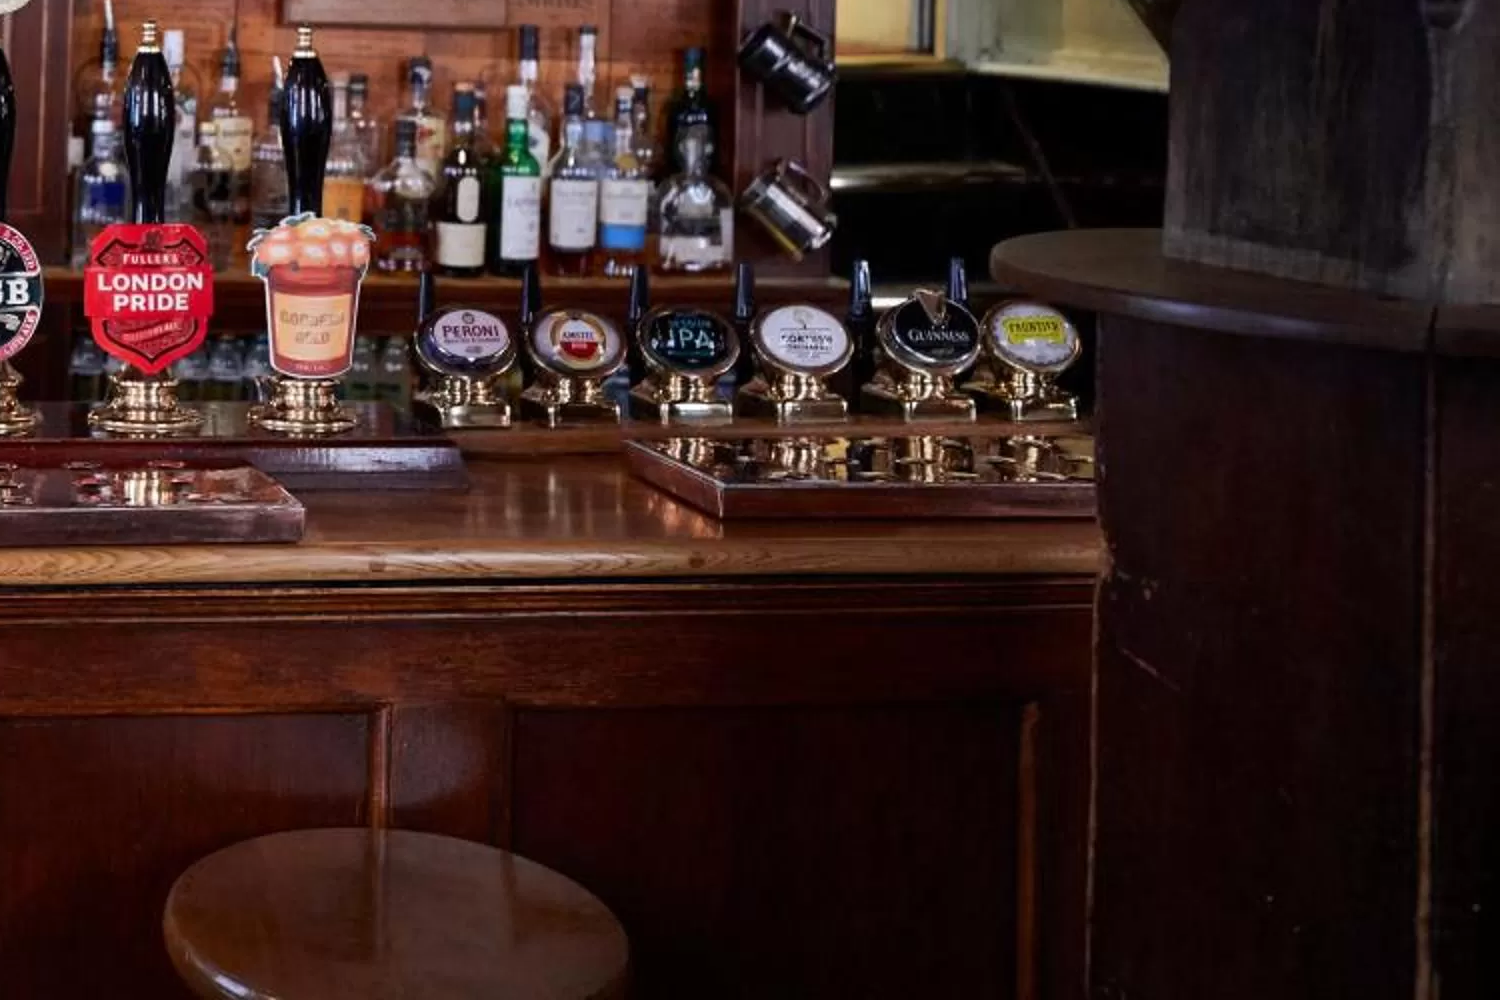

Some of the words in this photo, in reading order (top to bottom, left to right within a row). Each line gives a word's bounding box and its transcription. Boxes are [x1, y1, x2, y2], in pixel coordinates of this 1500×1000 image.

[97, 271, 204, 291] LONDON
[112, 293, 190, 312] PRIDE
[442, 325, 499, 337] PERONI
[668, 328, 712, 349] IPA
[907, 327, 970, 342] GUINNESS
